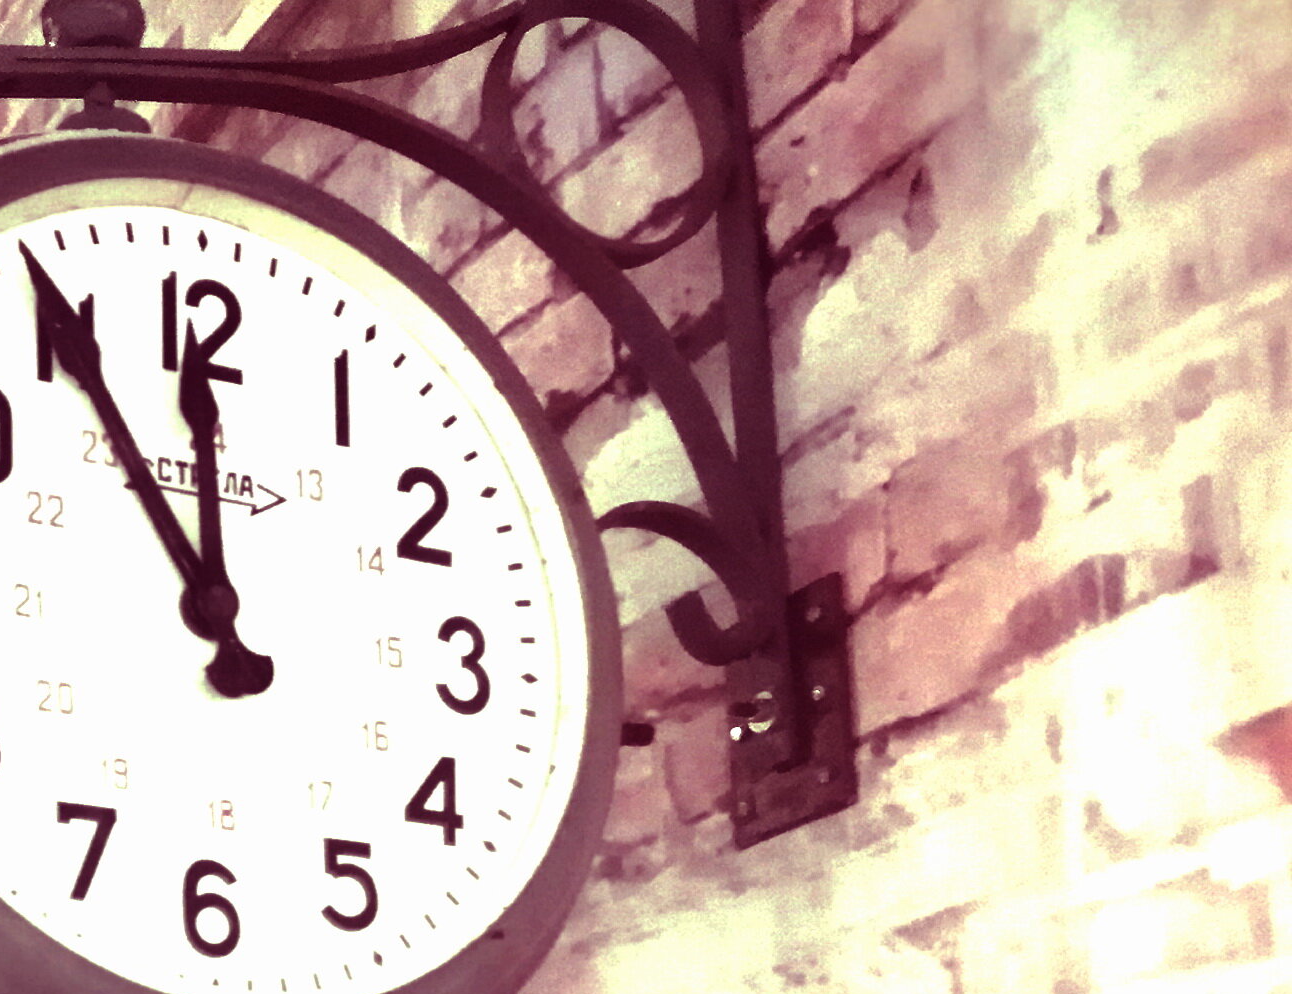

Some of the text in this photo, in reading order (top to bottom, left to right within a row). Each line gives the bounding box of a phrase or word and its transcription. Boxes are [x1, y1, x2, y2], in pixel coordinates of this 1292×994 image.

[162, 271, 243, 385] 12
[333, 349, 351, 448] 1
[158, 457, 254, 498] СТЛА
[297, 469, 323, 502] 13
[27, 491, 64, 528] 22
[396, 467, 452, 567] 2
[357, 545, 385, 576] 14
[15, 584, 42, 618] 21
[376, 637, 402, 668] 15
[435, 616, 491, 715] 3
[37, 680, 73, 714] 20
[362, 721, 388, 751] 16
[308, 781, 332, 810] 17
[404, 756, 464, 846] 4
[209, 800, 235, 831] 18
[56, 801, 117, 902] 7
[321, 838, 379, 933] 5
[182, 858, 241, 958] 6
